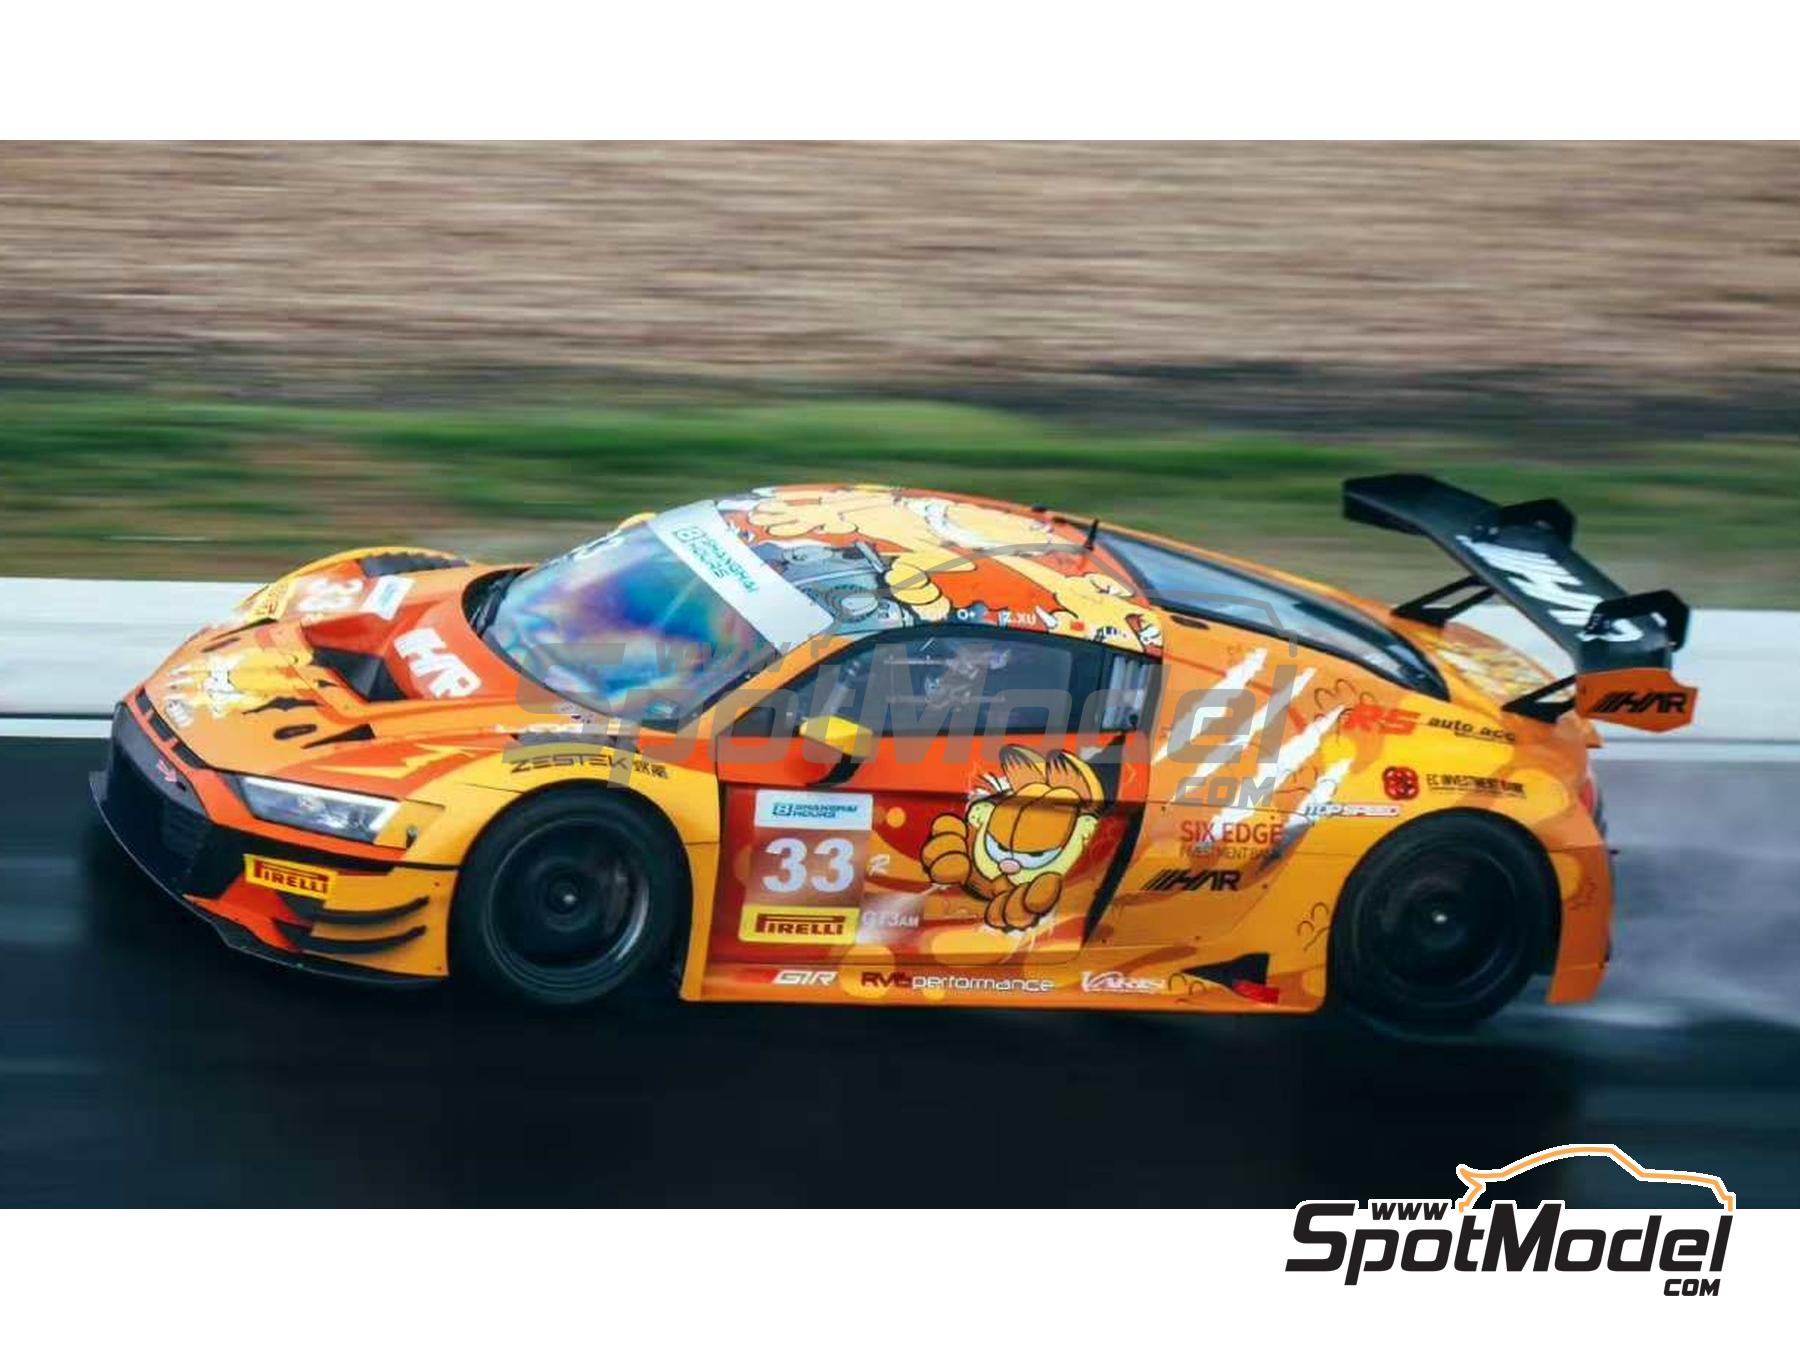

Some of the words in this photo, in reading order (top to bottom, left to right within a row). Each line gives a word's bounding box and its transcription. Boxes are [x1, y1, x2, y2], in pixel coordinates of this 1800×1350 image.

[510, 753, 629, 774] ZESTEK
[1181, 820, 1216, 843] SIX
[1222, 822, 1284, 845] EDGE
[253, 858, 330, 894] PIRELLI
[763, 836, 855, 893] 33
[754, 912, 847, 936] PIRELLI
